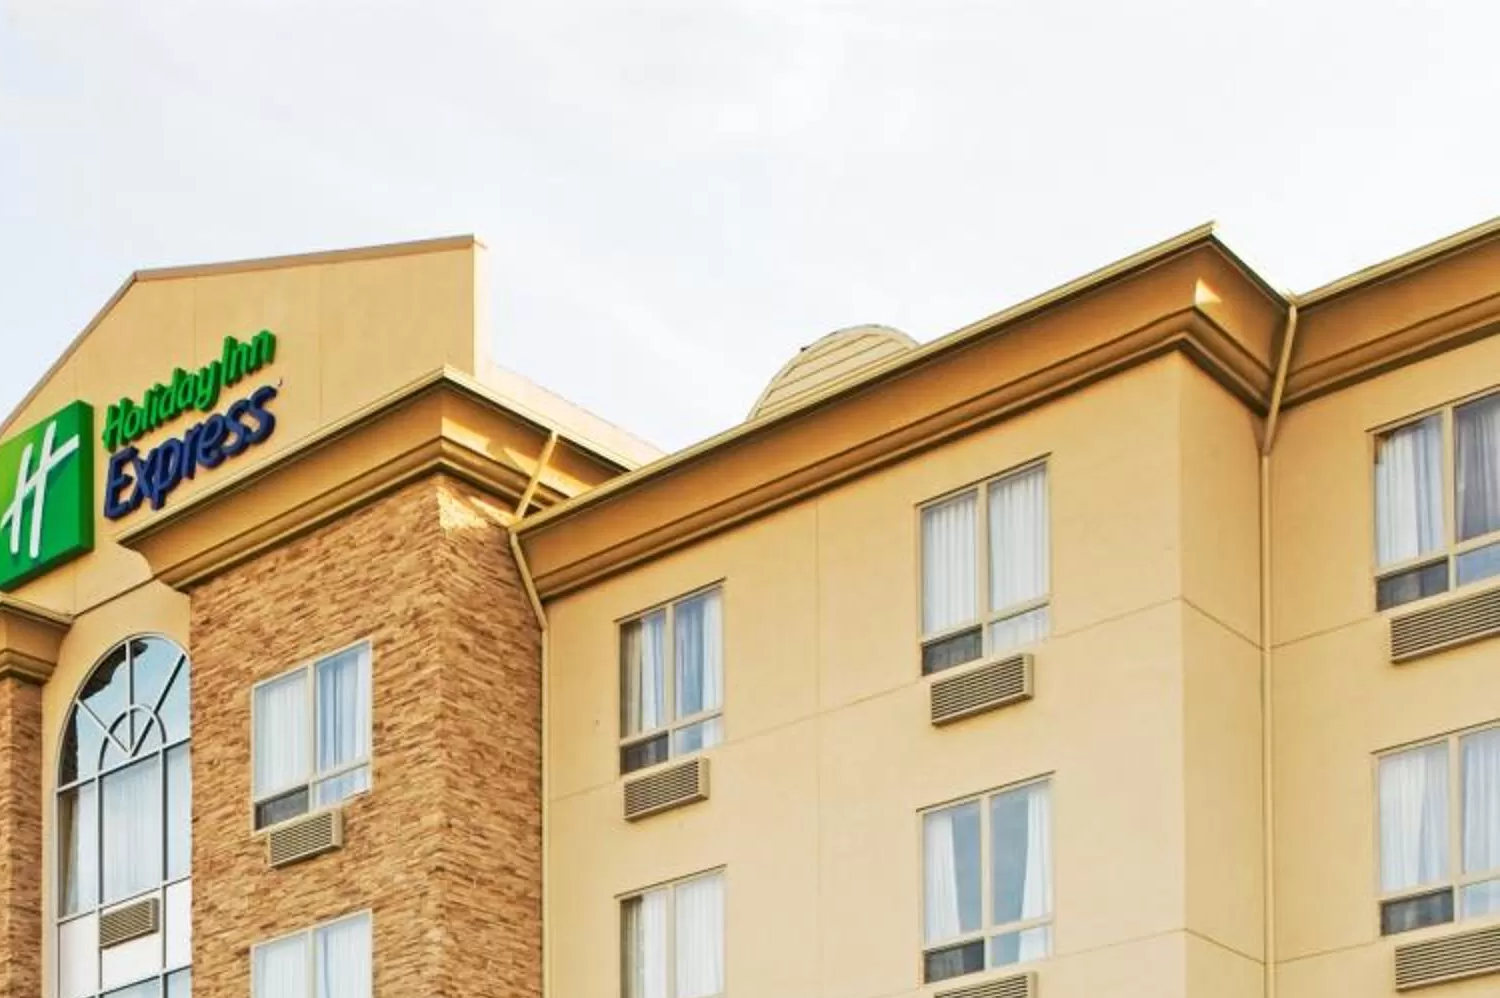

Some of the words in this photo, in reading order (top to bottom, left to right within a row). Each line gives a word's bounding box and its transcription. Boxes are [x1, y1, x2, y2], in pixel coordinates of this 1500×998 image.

[102, 360, 220, 449] Holiday
[219, 330, 276, 386] Inn
[103, 385, 277, 521] Express
[1, 421, 79, 558] H
